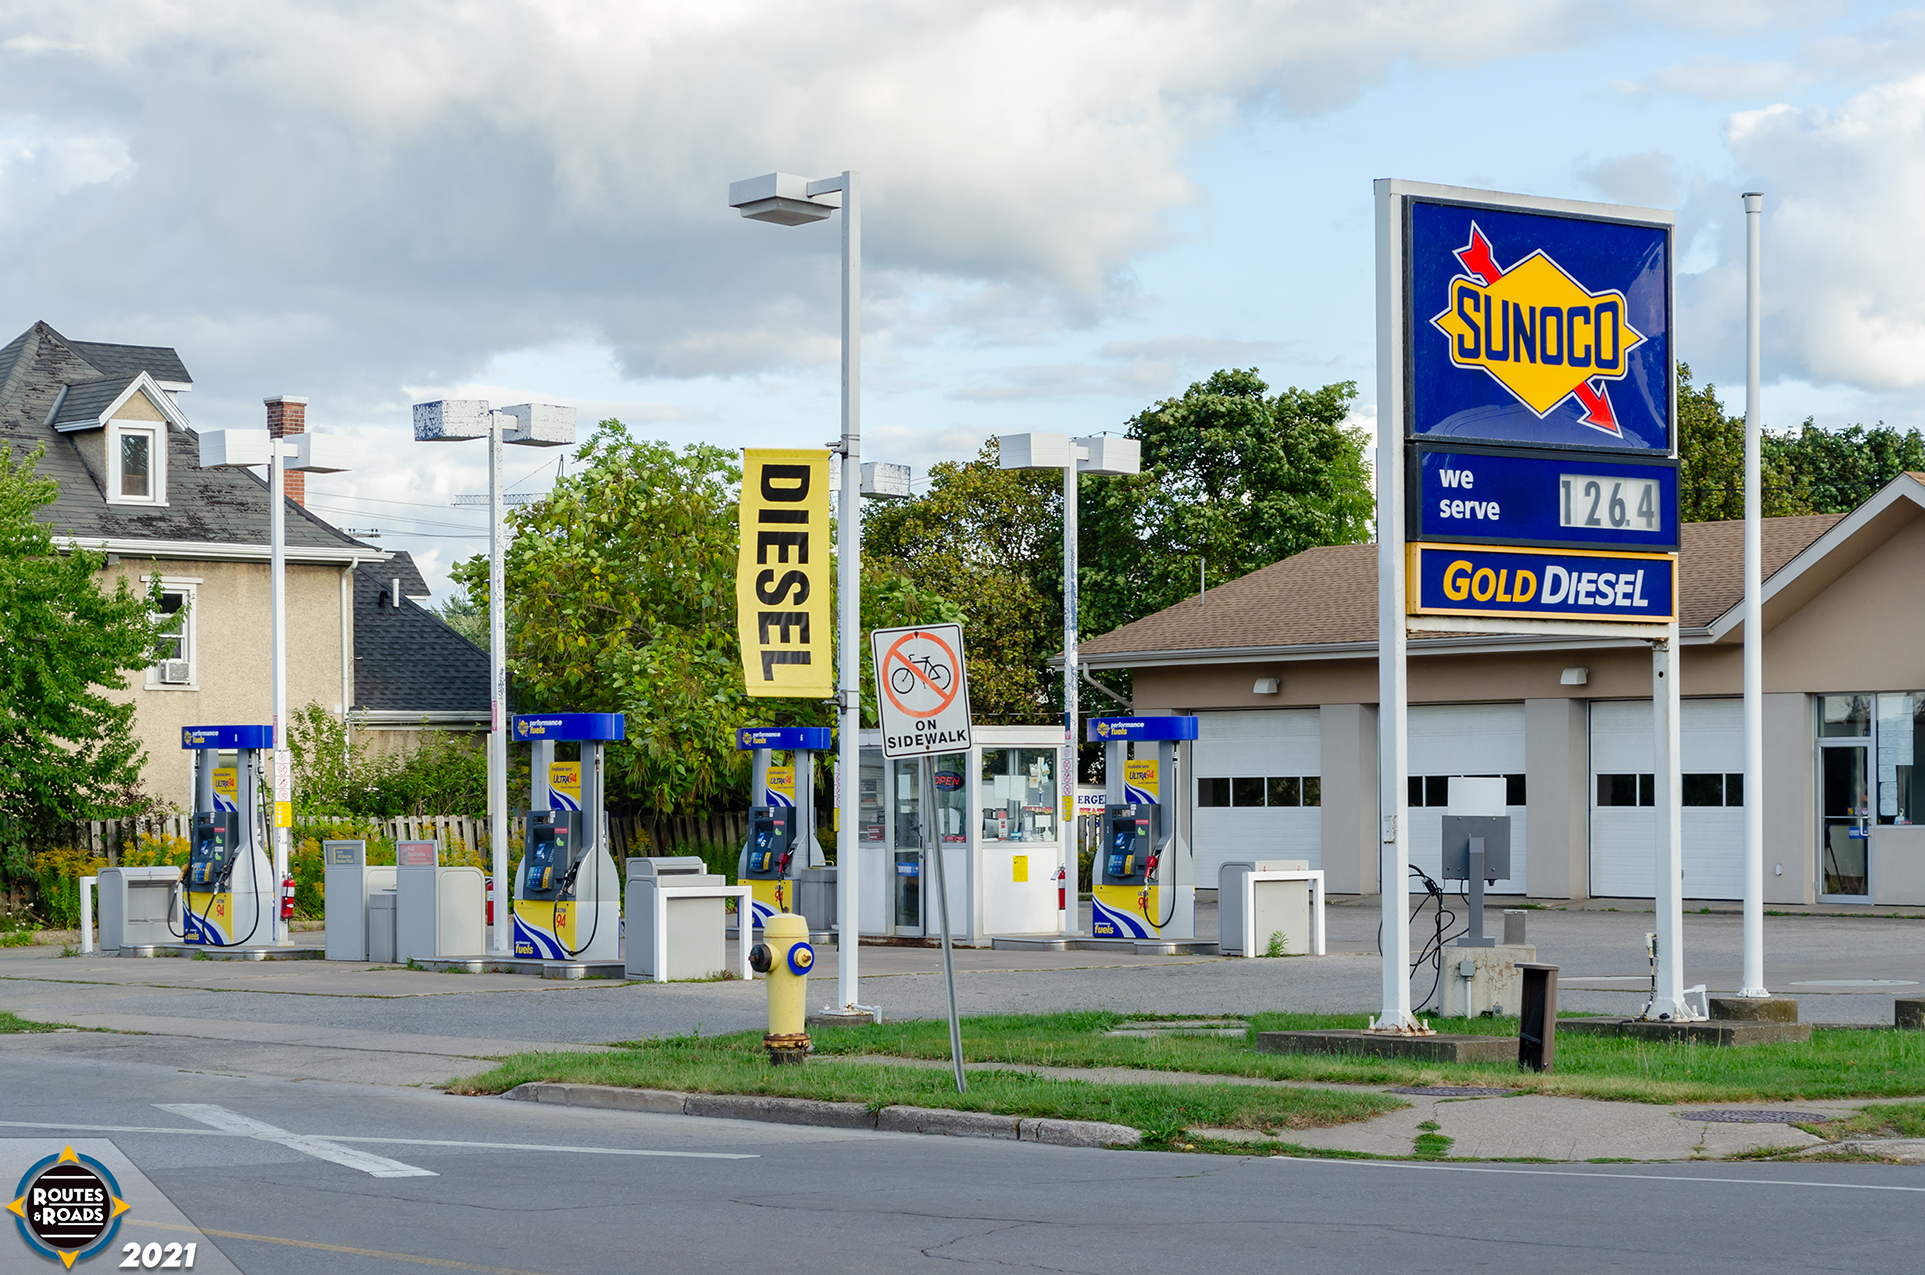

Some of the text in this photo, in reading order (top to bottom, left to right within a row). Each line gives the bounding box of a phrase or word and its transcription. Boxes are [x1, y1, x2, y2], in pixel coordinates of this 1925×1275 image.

[1456, 285, 1619, 369] SUNOCO
[1439, 469, 1474, 489] we
[1439, 499, 1500, 521] serve
[1561, 480, 1655, 529] 126.4
[756, 464, 812, 681] DIESEL
[1443, 560, 1649, 608] GOLD DIESEL
[529, 719, 563, 727] performance
[529, 726, 546, 734] fuels
[915, 719, 937, 732] ON
[1110, 721, 1145, 729] performance
[887, 729, 967, 749] SIDEWALK
[935, 776, 960, 786] OPEN
[216, 904, 225, 918] 94
[556, 914, 567, 929] 94
[1094, 924, 1114, 934] fuels
[515, 944, 534, 955] fuels
